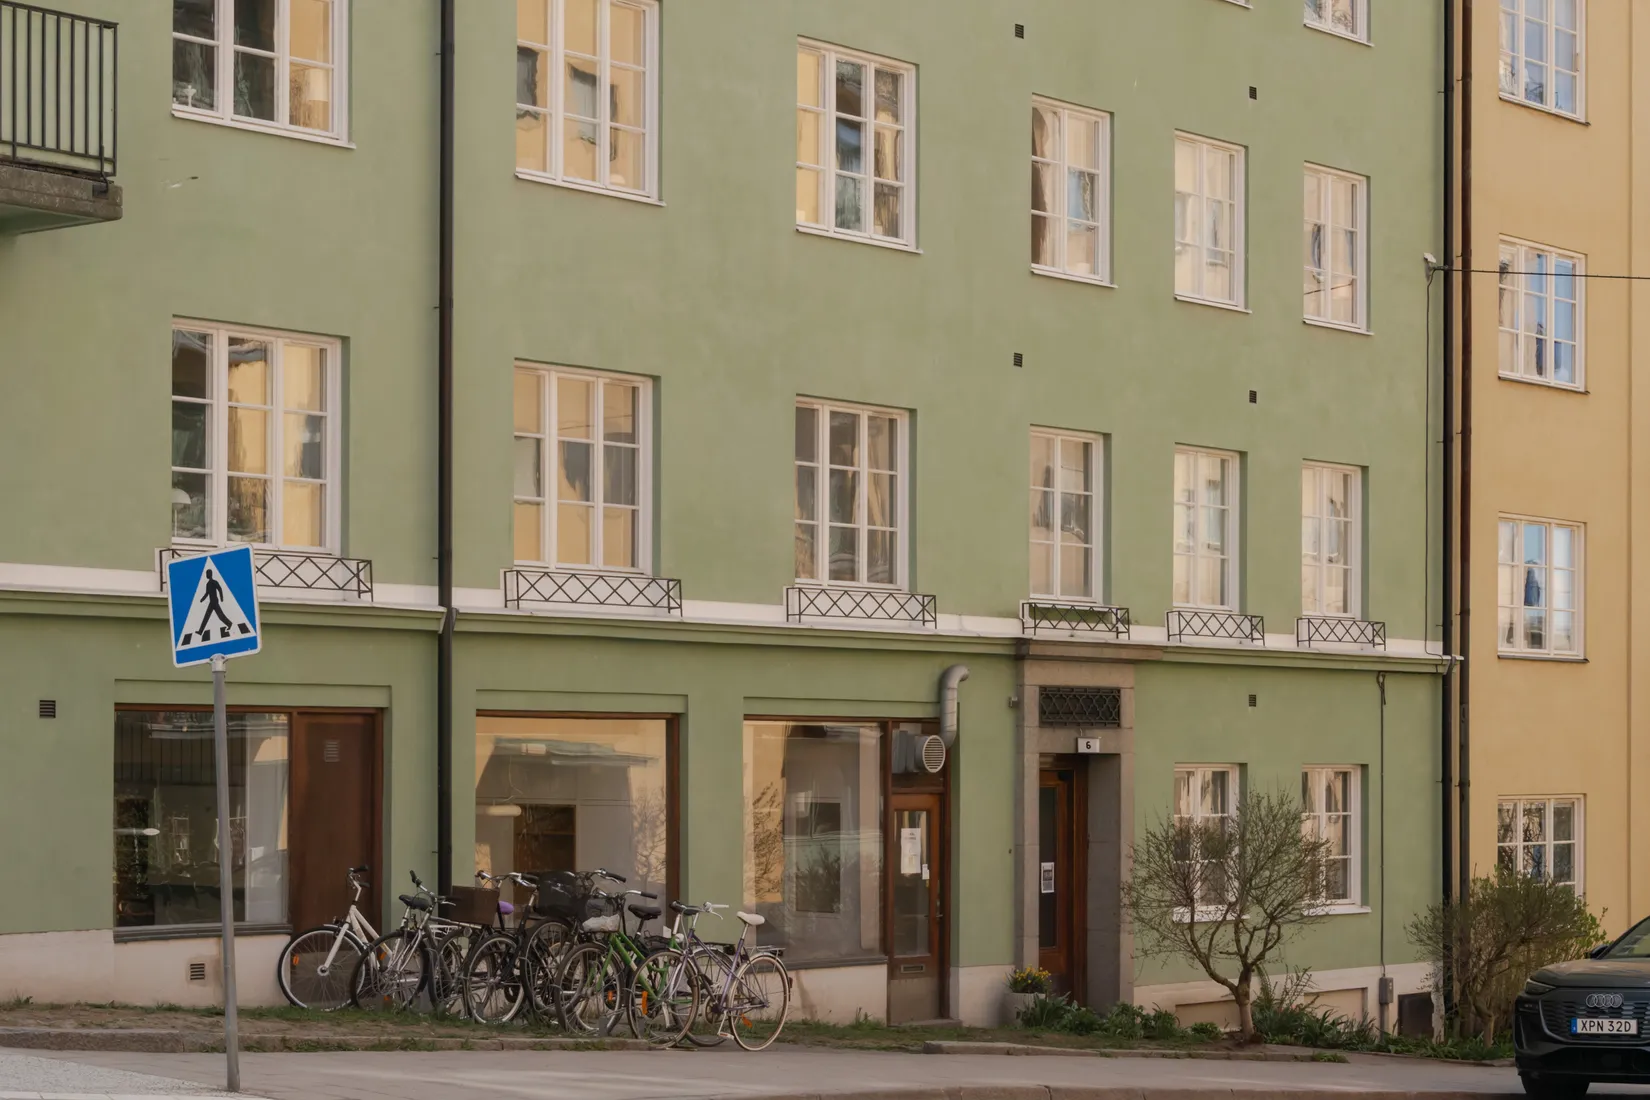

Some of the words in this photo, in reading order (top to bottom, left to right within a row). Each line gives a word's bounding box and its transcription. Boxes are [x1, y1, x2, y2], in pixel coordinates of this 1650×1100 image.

[1085, 740, 1092, 750] 6
[1581, 1020, 1604, 1032] XPN
[1607, 1020, 1632, 1032] 32D
